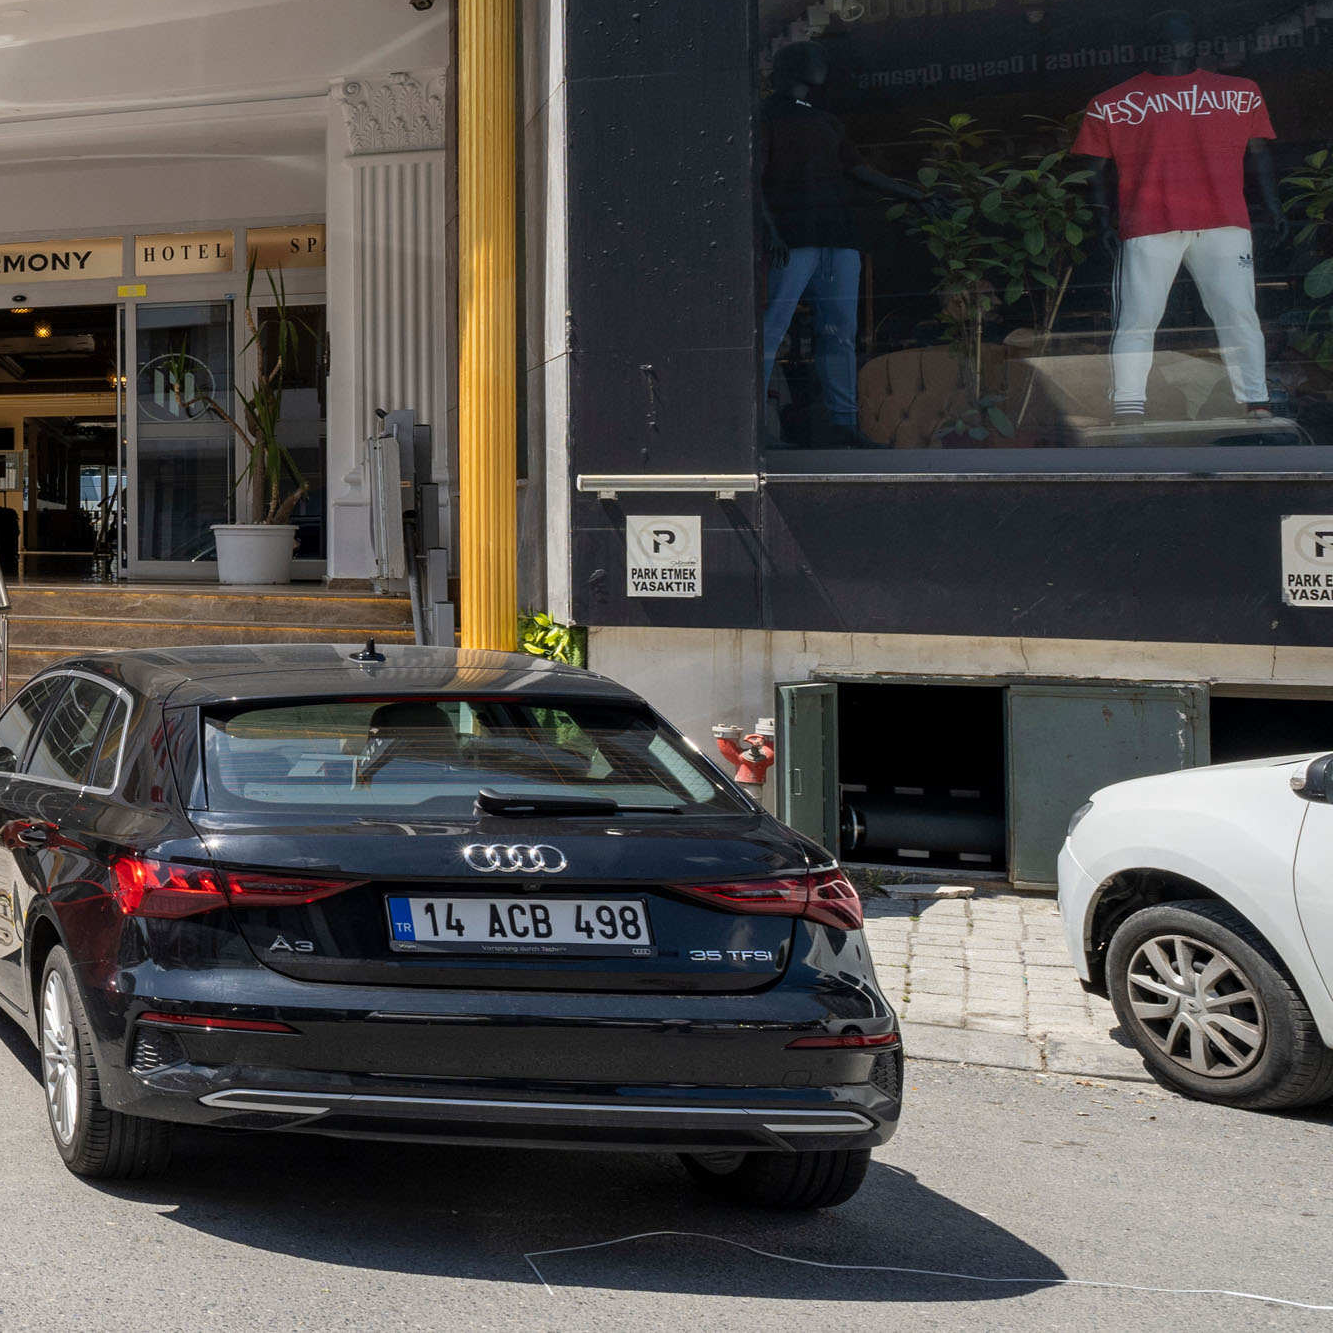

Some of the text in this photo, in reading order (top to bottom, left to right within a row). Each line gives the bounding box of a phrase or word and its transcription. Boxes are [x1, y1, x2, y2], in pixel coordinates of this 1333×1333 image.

[143, 242, 227, 263] HOTEL
[290, 236, 326, 254] SP
[631, 568, 696, 580] PARK ETMEK
[633, 581, 696, 592] YASAKTIR
[1288, 574, 1321, 587] PARK
[1290, 589, 1333, 600] YASA
[396, 903, 642, 940] TR 14 ACB 498
[269, 936, 314, 953] A3
[690, 950, 773, 962] 35 TFSI
